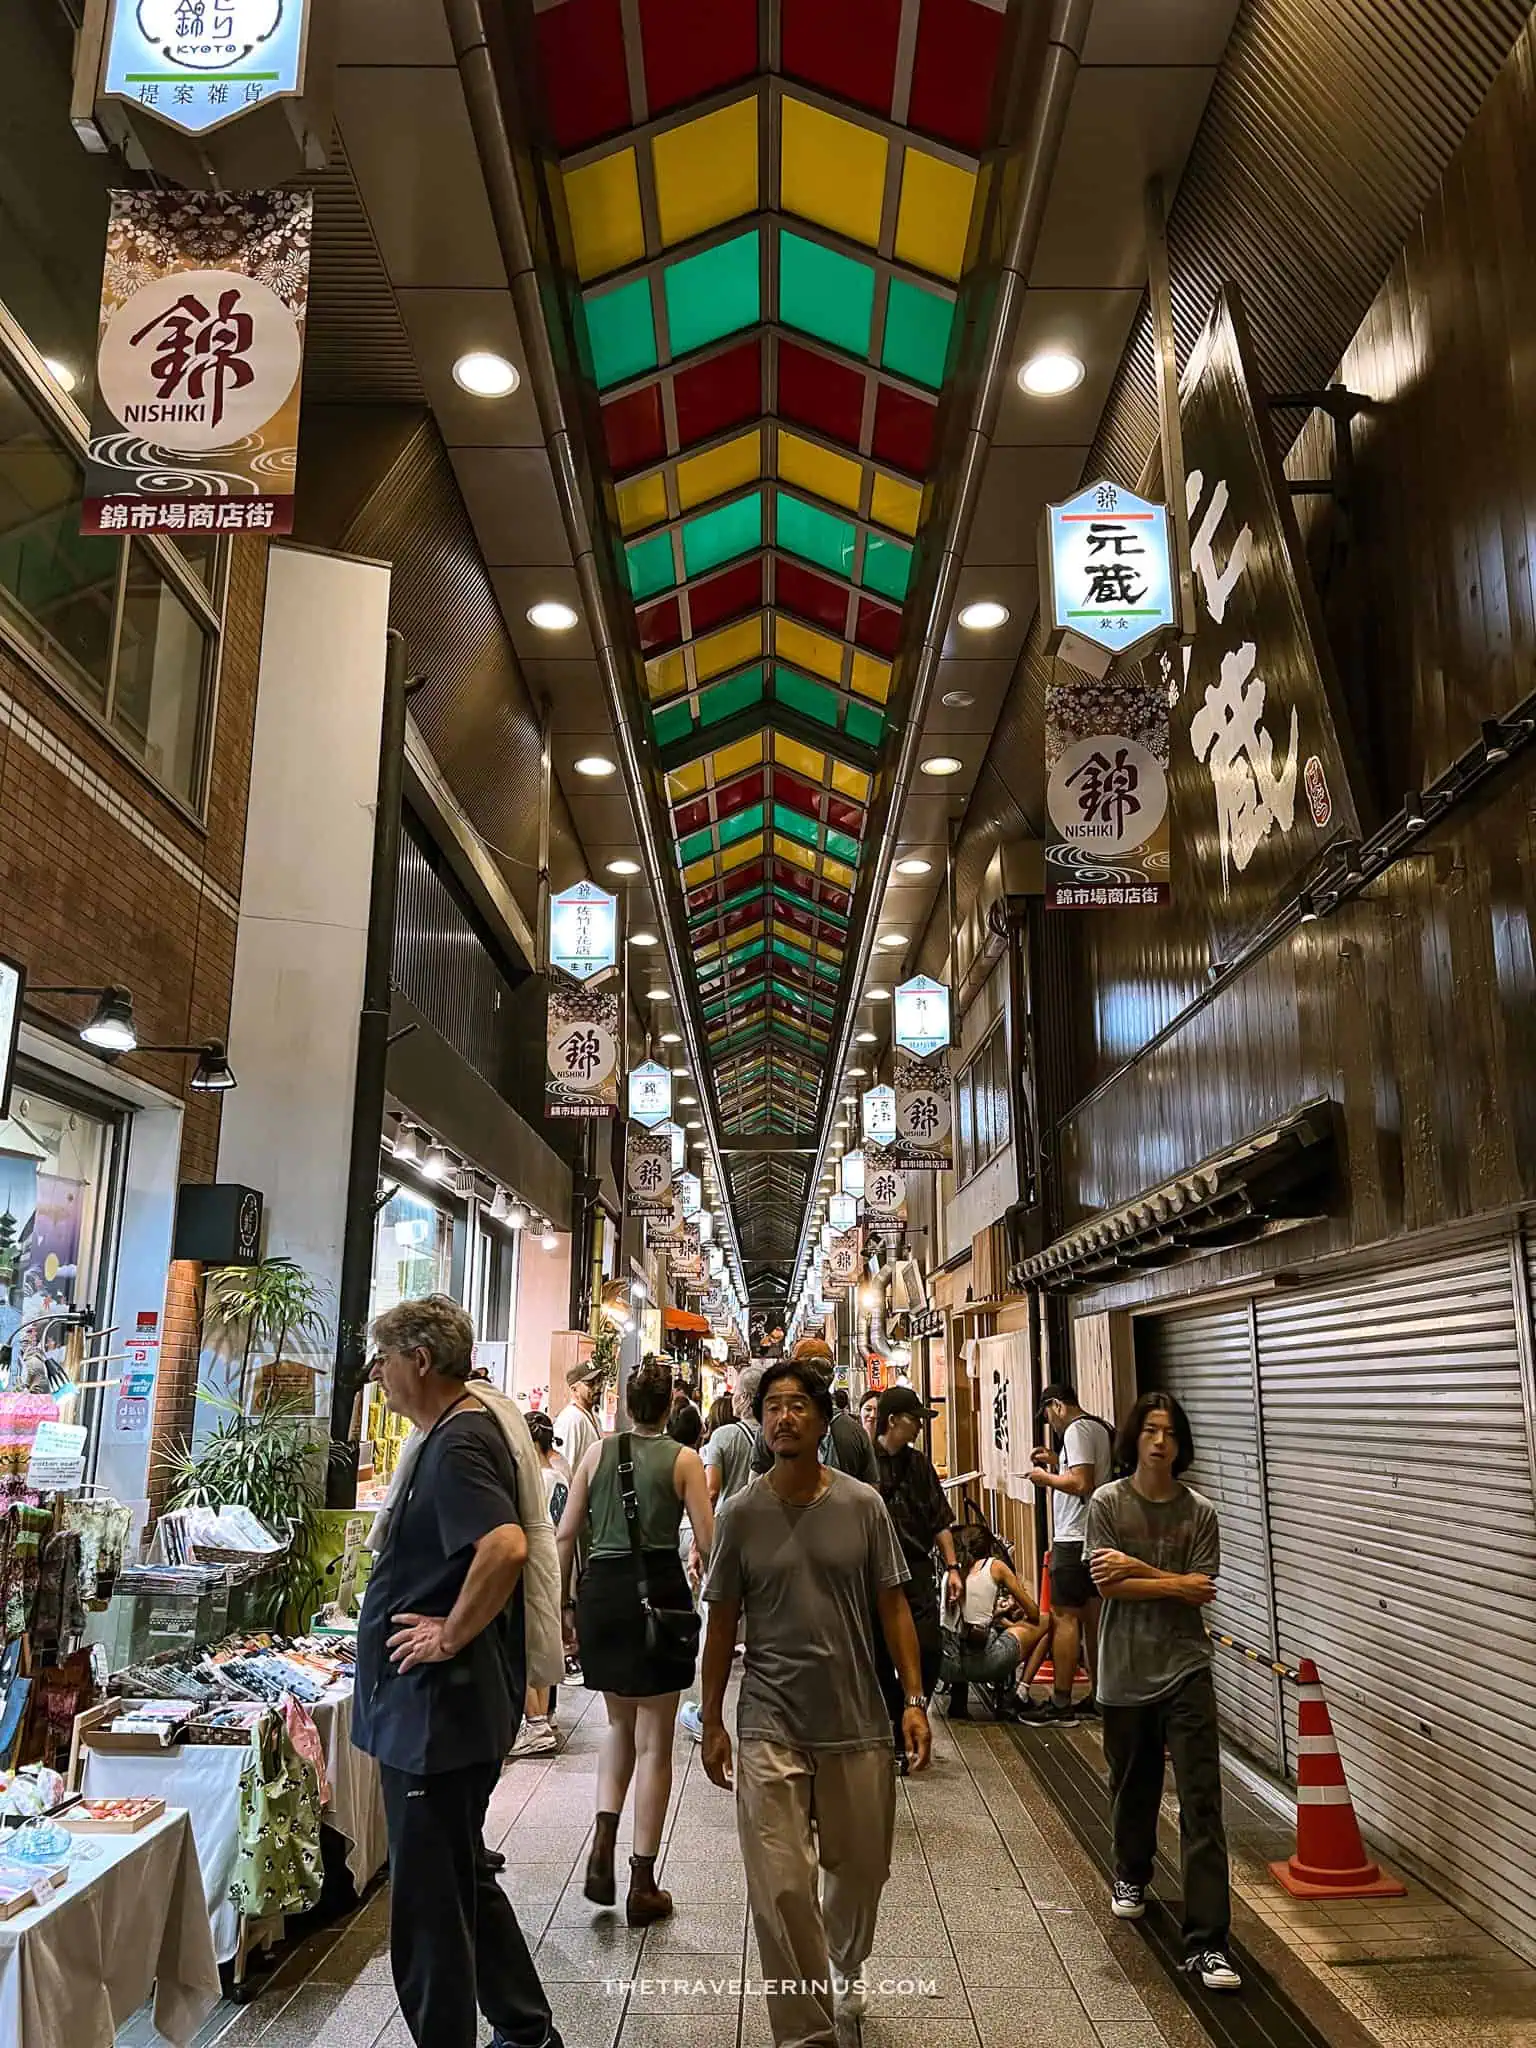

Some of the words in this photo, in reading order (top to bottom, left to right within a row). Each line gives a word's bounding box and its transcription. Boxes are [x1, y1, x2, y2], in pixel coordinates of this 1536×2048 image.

[176, 44, 237, 55] KYOTO
[138, 83, 264, 105] 提案雑貨
[130, 289, 255, 429] 錦
[124, 404, 206, 424] NISHIKI
[1092, 485, 1118, 512] 錦
[99, 502, 274, 530] 錦市場商店街
[1081, 523, 1149, 607] 元蔵
[1100, 617, 1129, 630] 飲食
[1064, 748, 1142, 841] 錦
[1065, 824, 1114, 838] NISHIKI
[1056, 887, 1159, 905] 錦市場商店街
[558, 1030, 601, 1080] 錦
[903, 1096, 940, 1138] 錦
[634, 1158, 663, 1192] 錦
[870, 1174, 897, 1206] 錦
